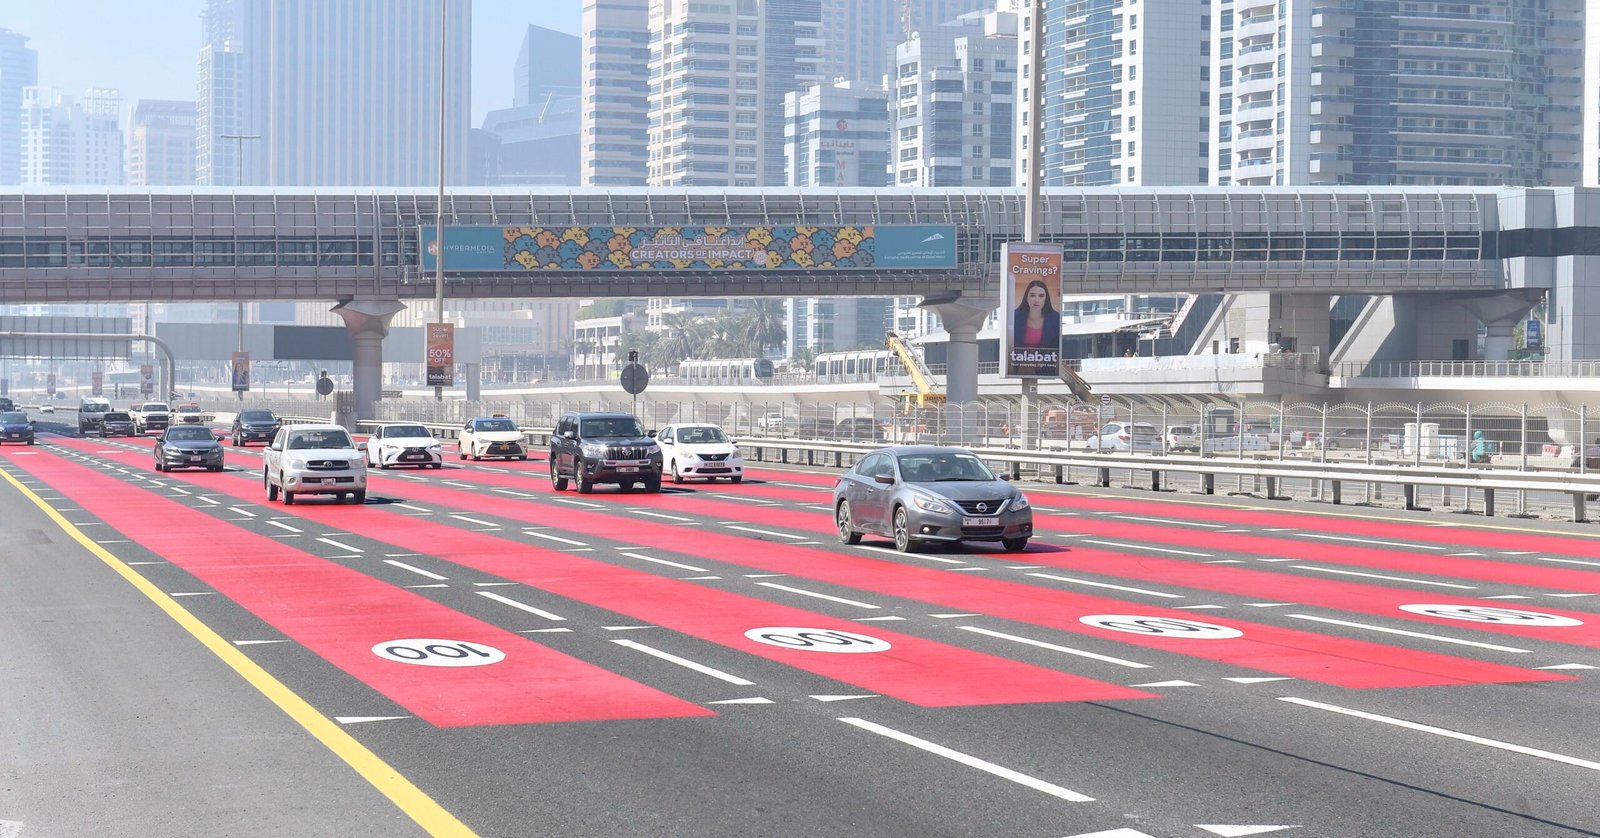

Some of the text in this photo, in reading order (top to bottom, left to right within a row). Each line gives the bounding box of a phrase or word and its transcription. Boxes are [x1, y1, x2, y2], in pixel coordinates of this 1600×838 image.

[682, 235, 702, 250] في
[631, 250, 753, 260] CREATORS OF IMPACT
[1021, 254, 1049, 265] Super
[1012, 265, 1058, 276] Cravings?
[429, 349, 451, 358] 50%
[1010, 350, 1058, 362] talabat
[1099, 618, 1221, 633] 100
[761, 631, 875, 647] 100
[385, 643, 491, 660] 100
